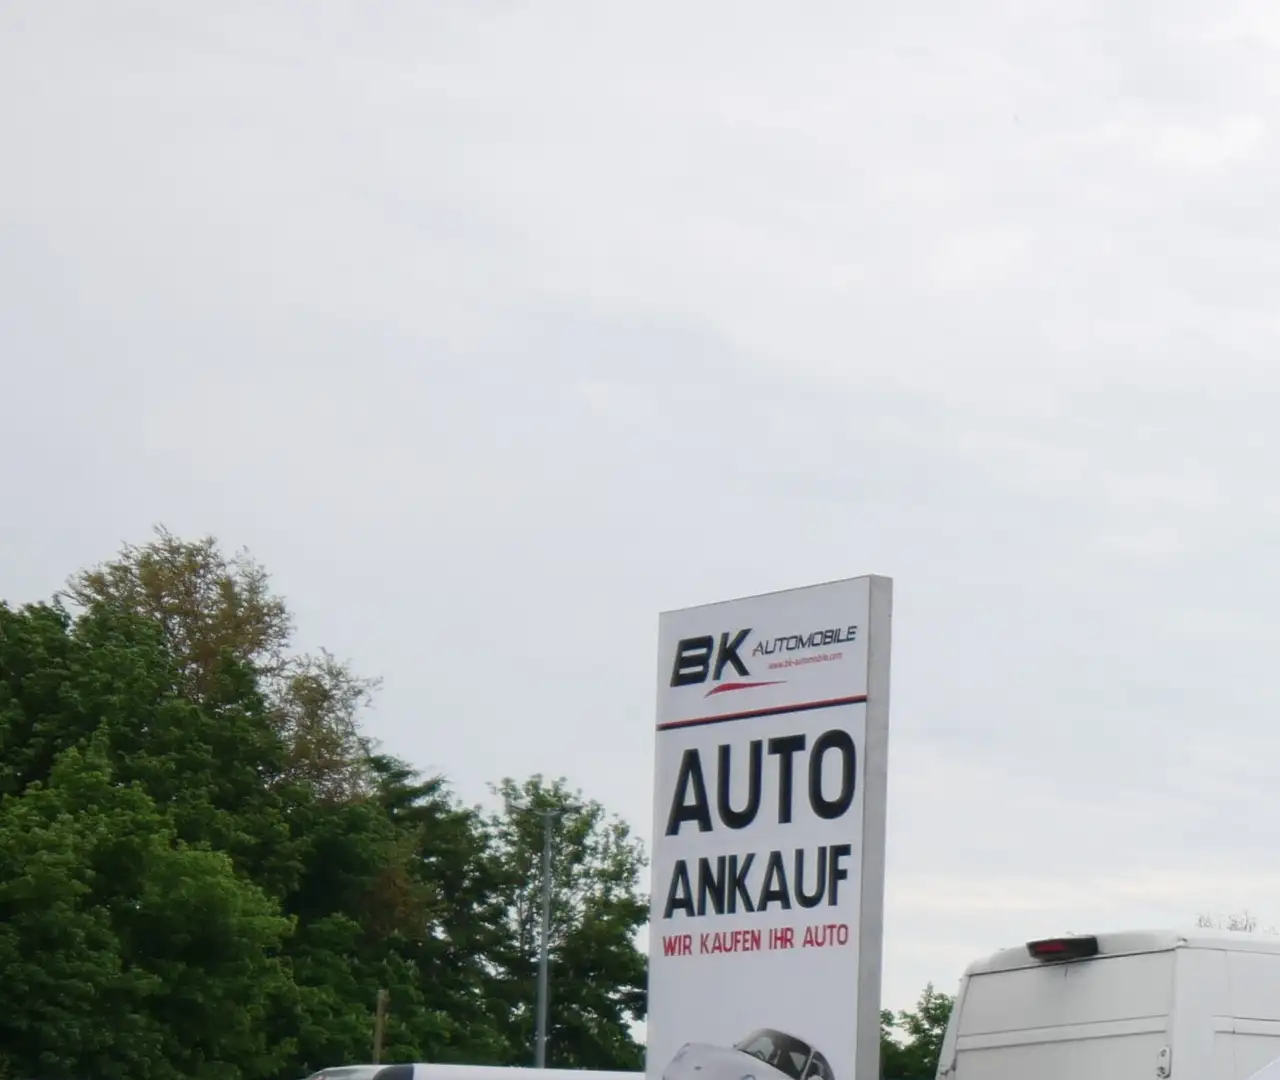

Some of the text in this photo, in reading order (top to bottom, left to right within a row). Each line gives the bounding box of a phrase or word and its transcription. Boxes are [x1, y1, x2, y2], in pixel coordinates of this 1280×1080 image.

[670, 628, 753, 688] BK
[752, 625, 858, 657] AUTOMOBILE
[665, 729, 857, 836] AUTO
[662, 843, 852, 919] ANKAUF
[662, 924, 848, 957] WIR KAUFEN IHR AUTO
